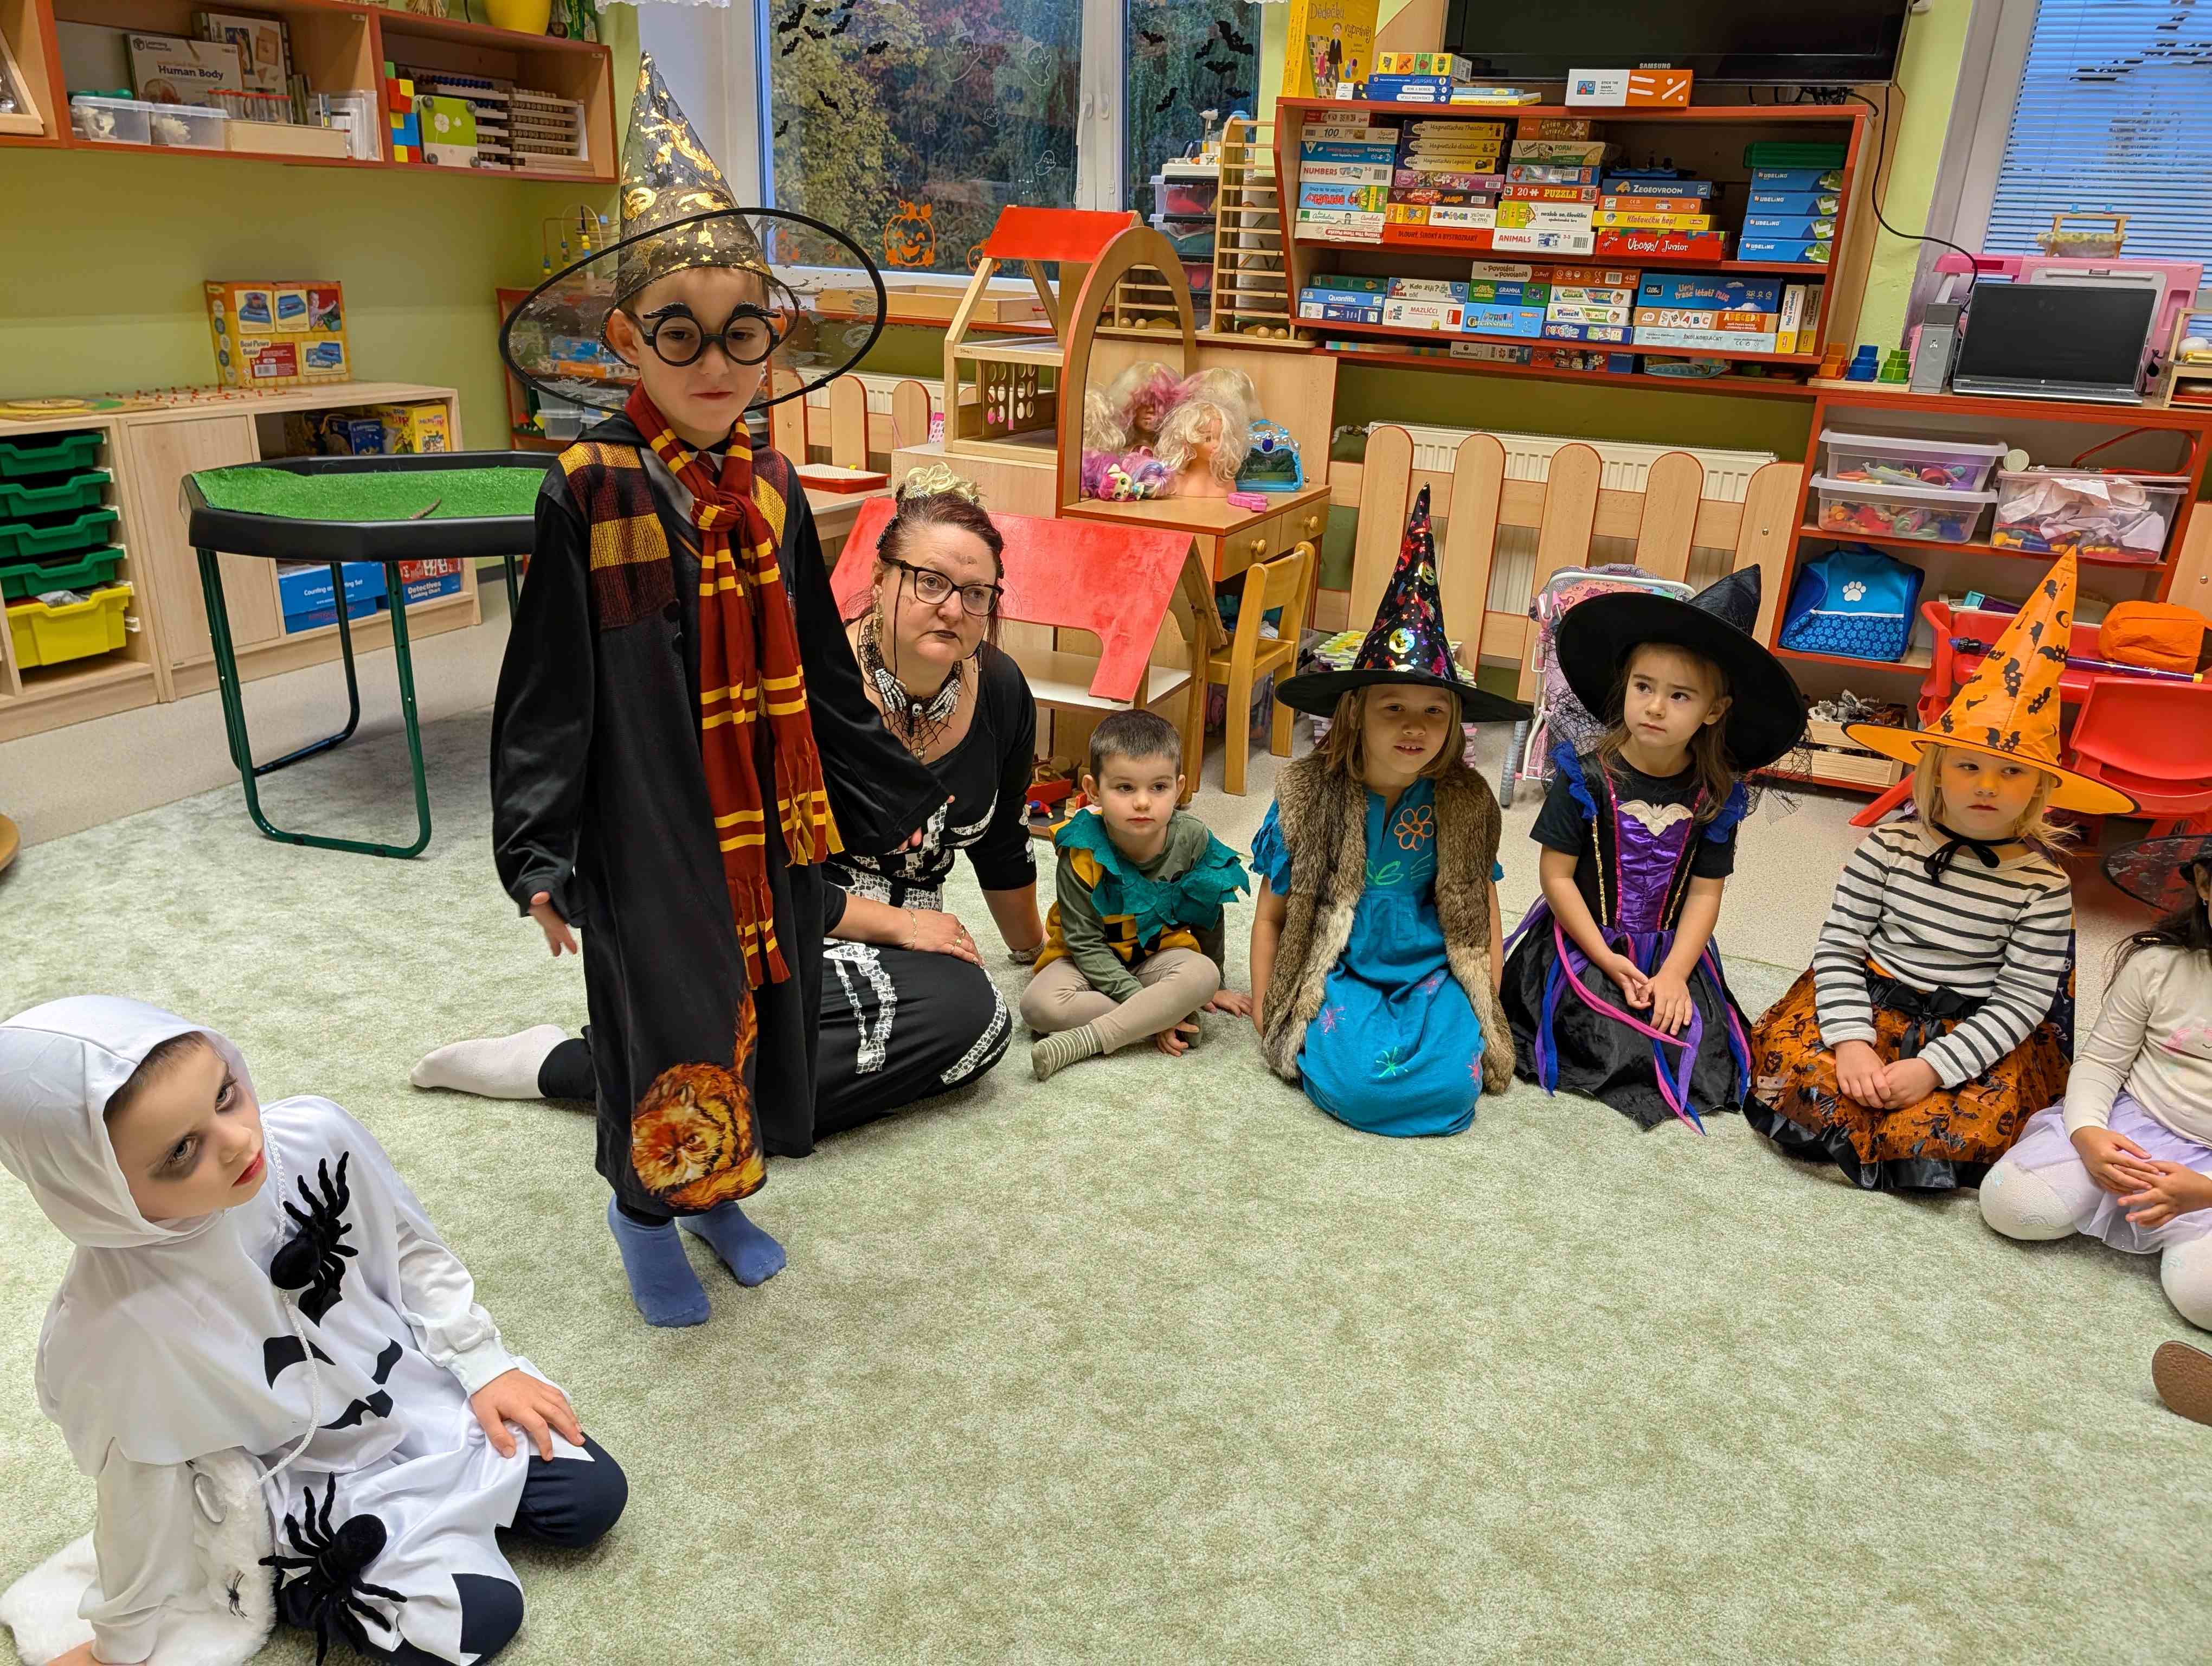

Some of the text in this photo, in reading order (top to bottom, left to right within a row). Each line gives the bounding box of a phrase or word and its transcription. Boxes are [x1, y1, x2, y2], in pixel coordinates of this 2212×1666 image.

[158, 65, 223, 80] Human Body
[1324, 129, 1339, 137] 100
[1303, 166, 1338, 175] NUMBERS
[1517, 188, 1577, 199] 20 PUZZLE
[1419, 231, 1437, 239] ŠIROKÝ
[1442, 233, 1478, 242] BYSTROZRAKÝ
[1499, 234, 1532, 244] ANIMALS
[1628, 238, 1689, 253] Ubongo! Junior
[1328, 294, 1356, 303] Quantitix
[1410, 306, 1438, 314] MAZLÍČCI
[1466, 316, 1515, 329] Carcassonne
[1682, 316, 1709, 325] A B C
[304, 587, 326, 596] Counting
